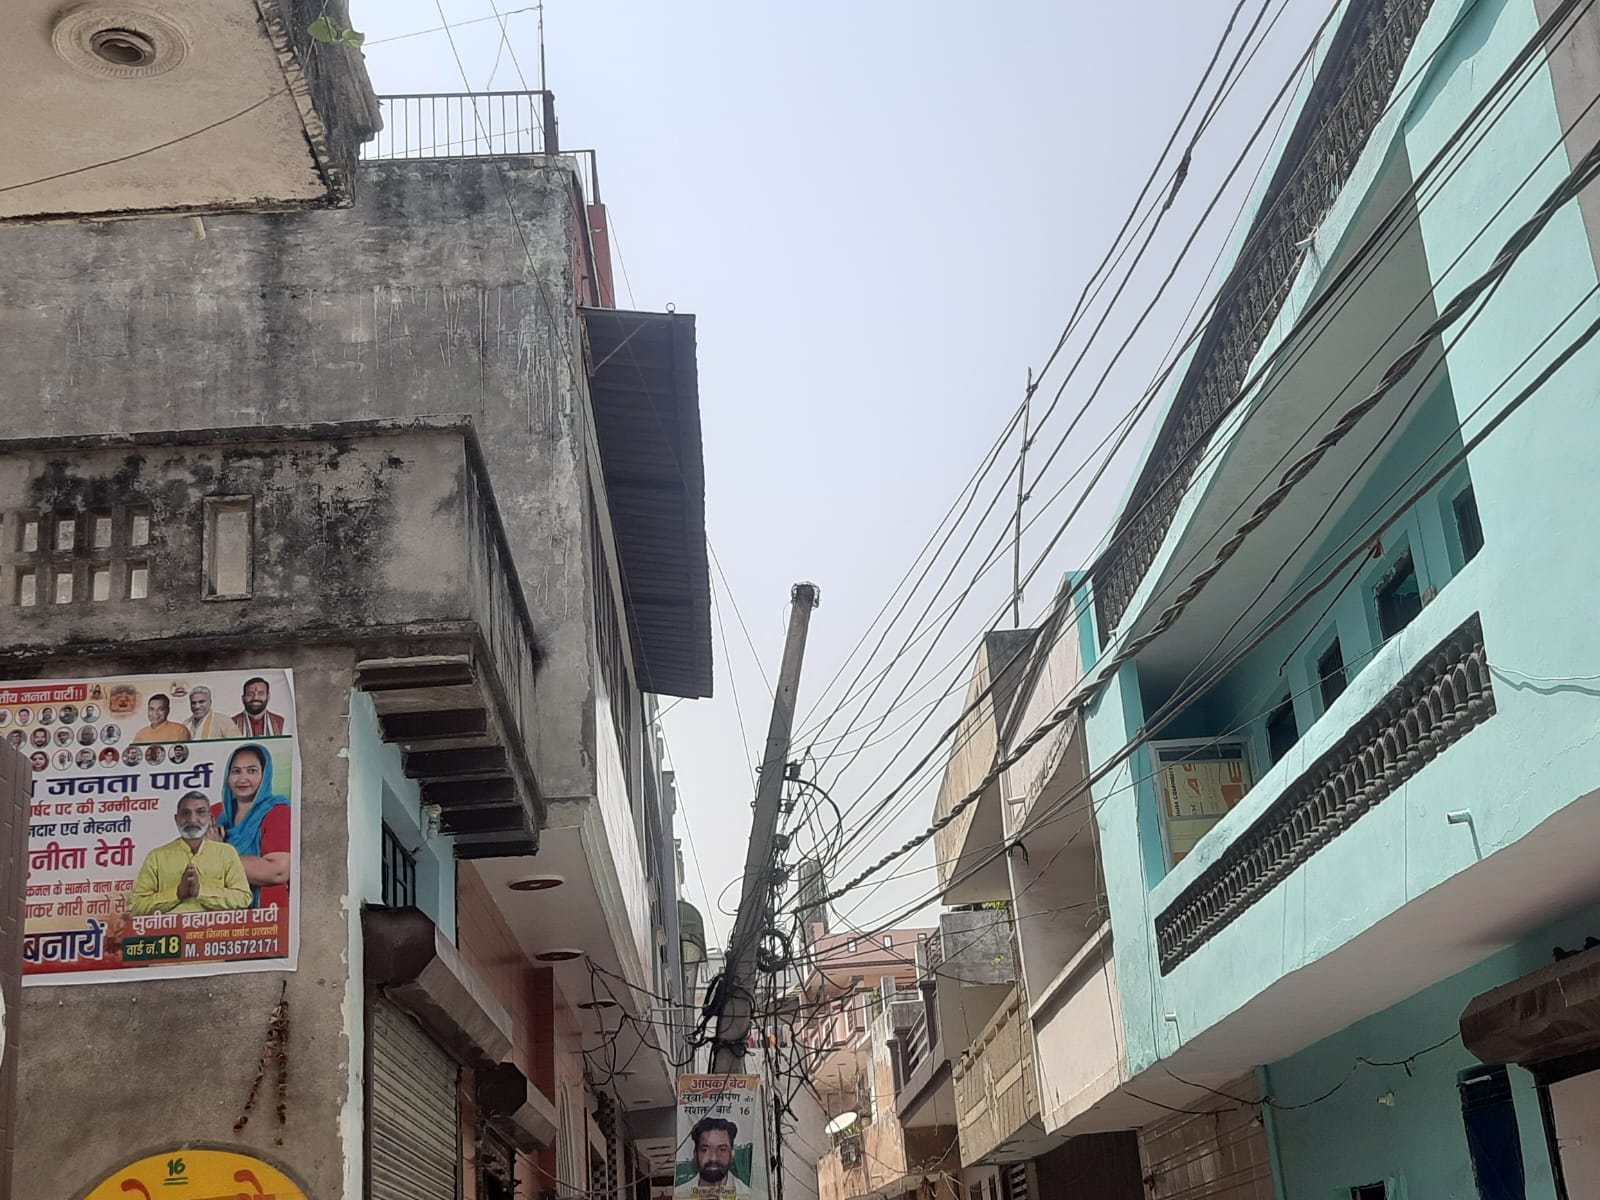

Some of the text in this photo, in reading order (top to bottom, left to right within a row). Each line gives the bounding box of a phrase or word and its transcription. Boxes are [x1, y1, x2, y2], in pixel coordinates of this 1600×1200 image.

[21, 690, 50, 702] जनता
[47, 774, 141, 796] जनता
[150, 763, 214, 790] पार्टी
[55, 803, 73, 816] पद
[76, 797, 94, 814] की
[99, 795, 160, 813] उम्मीदवार
[28, 815, 132, 837] नदार एवं मेहनती
[94, 837, 136, 867] देवी
[53, 880, 63, 895] के
[65, 878, 90, 895] सामने
[93, 881, 112, 893] वाला
[114, 880, 134, 892] बटन
[57, 896, 83, 916] भारी
[114, 894, 126, 913] से
[132, 910, 177, 935] सुनीता
[252, 903, 279, 923] राठी
[23, 919, 105, 961] बनायें
[126, 940, 144, 956] वार्ड
[204, 938, 278, 956] 8053672171
[740, 1107, 750, 1116] 16
[167, 1158, 186, 1176] 16
